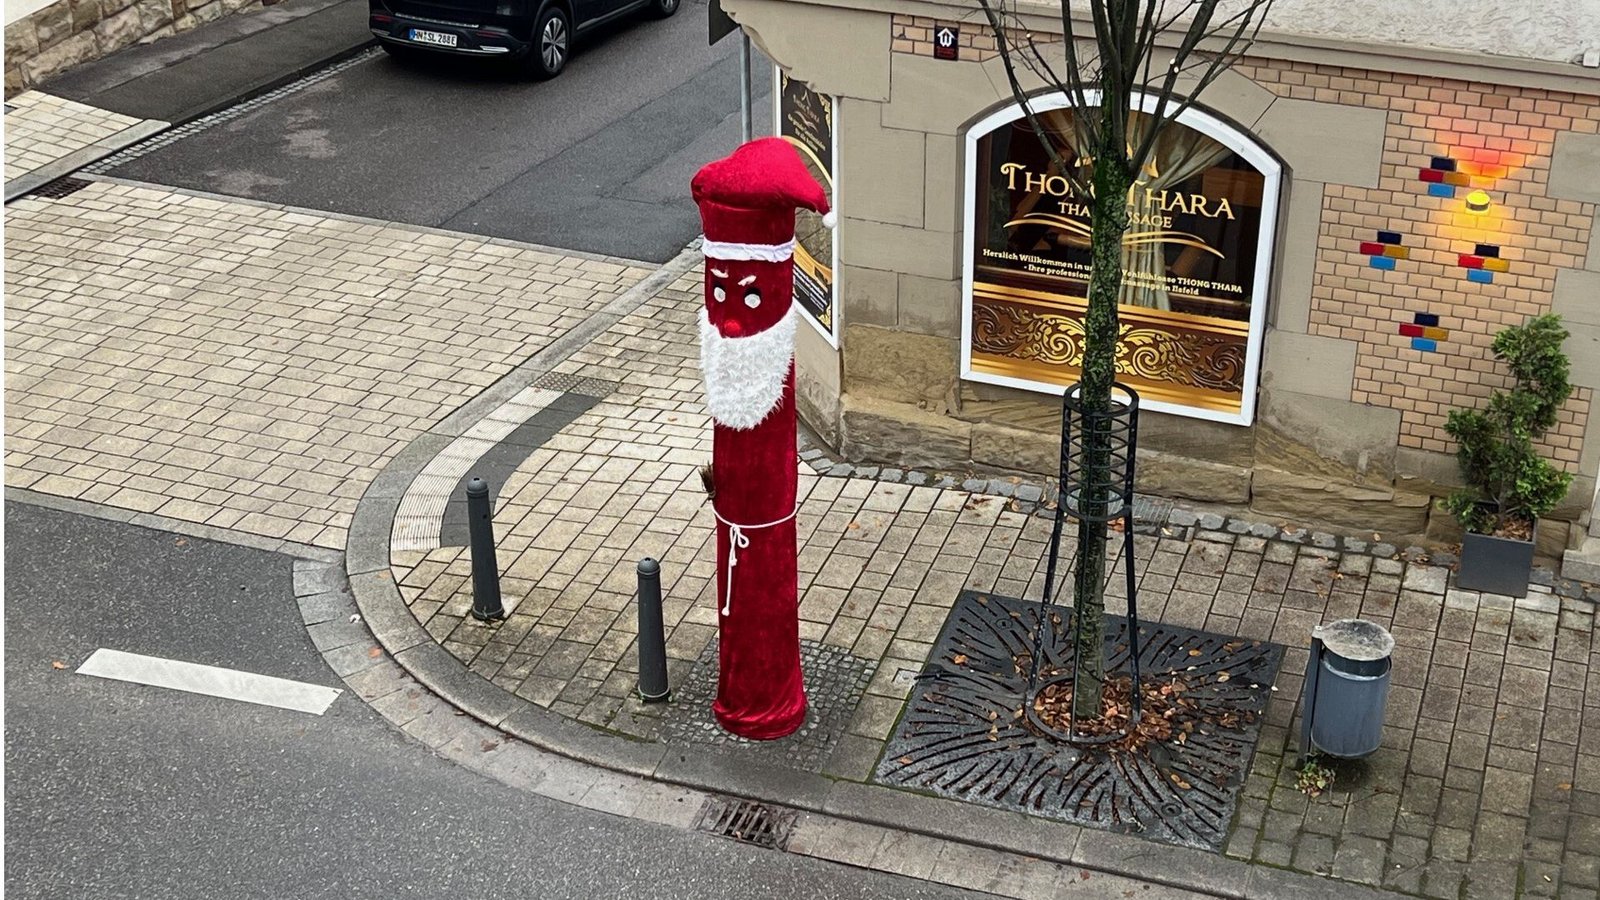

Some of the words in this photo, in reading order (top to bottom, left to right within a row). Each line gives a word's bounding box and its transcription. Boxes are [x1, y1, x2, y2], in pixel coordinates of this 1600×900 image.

[1000, 162, 1096, 200] THO
[1057, 201, 1092, 217] THA
[1019, 253, 1073, 269] Willkommen
[1074, 262, 1084, 271] in
[1177, 277, 1210, 289] THONG
[1211, 281, 1243, 294] THARA
[1028, 263, 1046, 274] Ihre
[1046, 267, 1092, 280] profession
[1161, 283, 1171, 292] in
[1171, 285, 1200, 296] Ilsfeld
